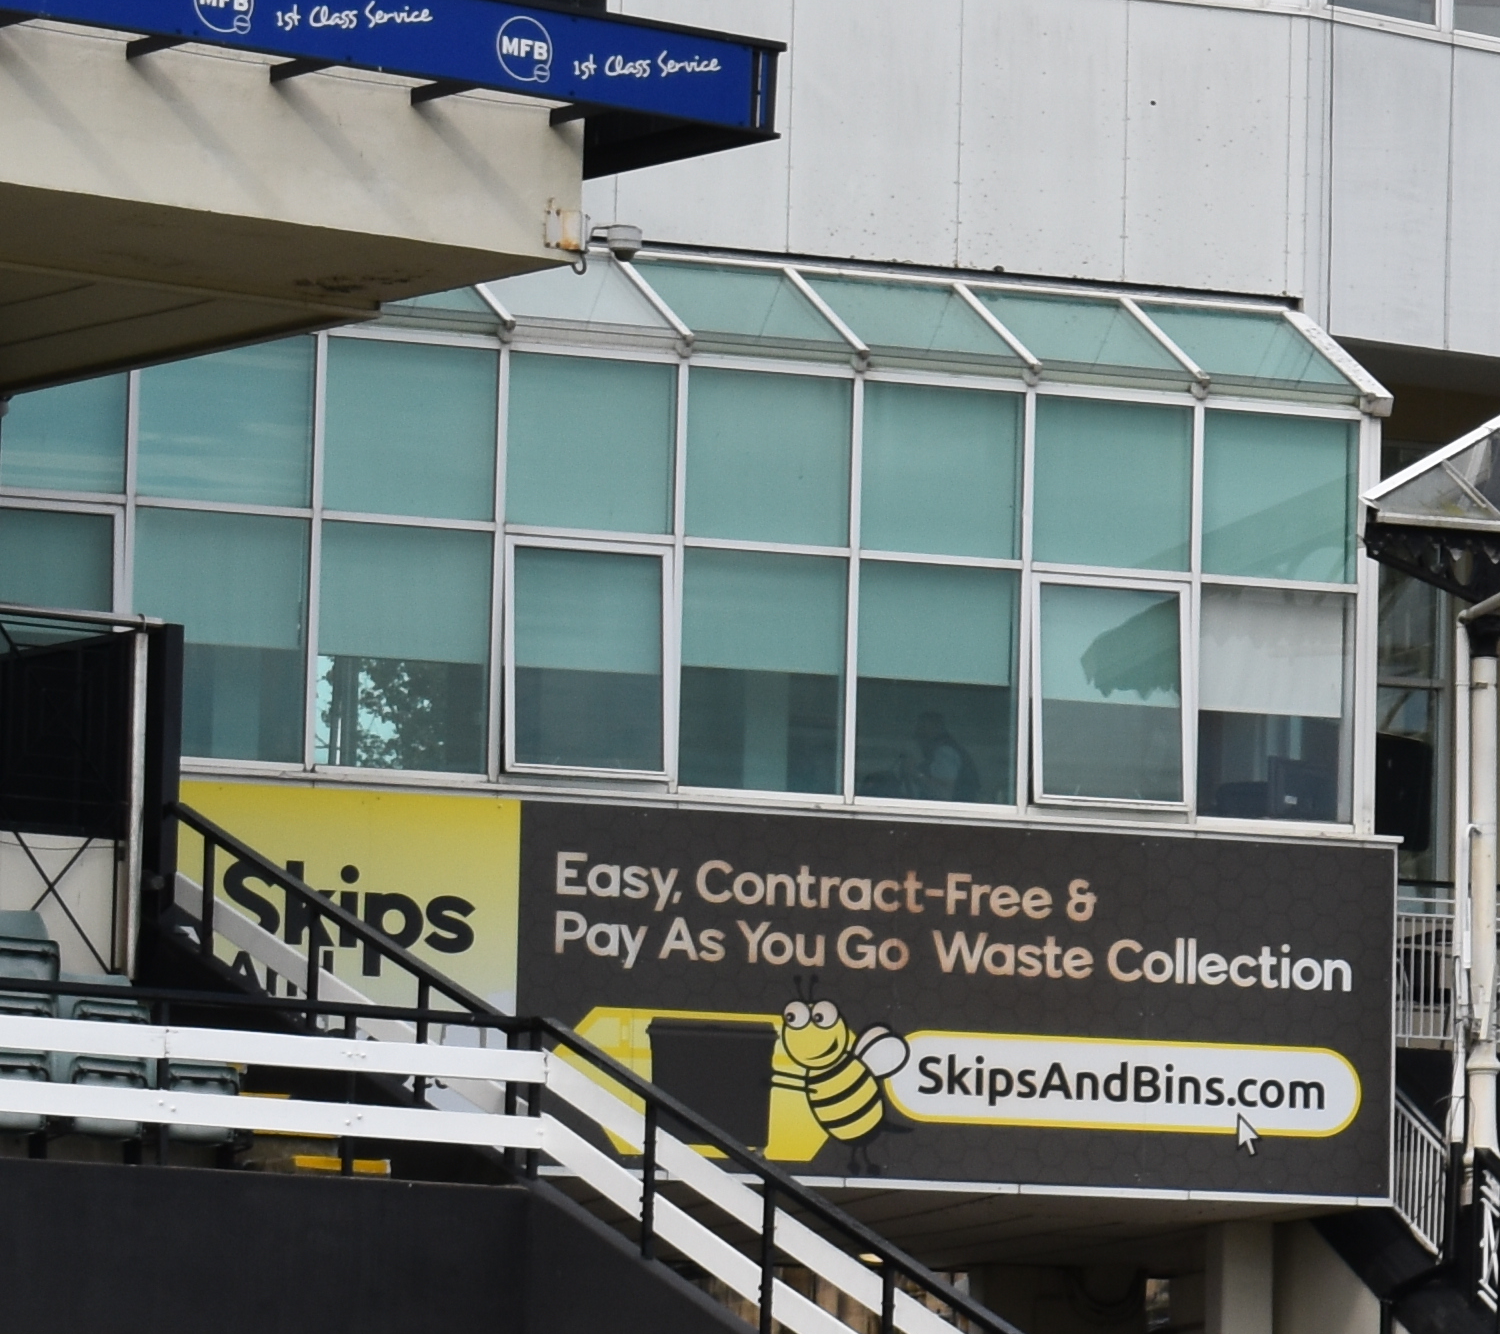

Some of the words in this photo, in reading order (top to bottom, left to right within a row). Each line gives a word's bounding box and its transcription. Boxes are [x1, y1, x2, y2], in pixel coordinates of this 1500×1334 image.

[275, 3, 302, 31] 1st
[308, 5, 359, 29] Class
[364, 0, 434, 29] Service
[502, 35, 548, 61] MFB
[572, 53, 598, 80] 1st
[604, 54, 652, 78] Class
[657, 49, 722, 78] Service
[555, 850, 683, 912] Easy,
[696, 859, 1054, 919] Contract-Free
[1065, 878, 1097, 922] &
[223, 860, 476, 977] Skips
[554, 910, 649, 969] Pay
[658, 916, 727, 963] As
[736, 919, 826, 965] You
[836, 925, 911, 971] Go
[932, 930, 1095, 979] Waste
[1106, 937, 1353, 993] Collection
[917, 1053, 1327, 1107] SkipsAndBins.com
